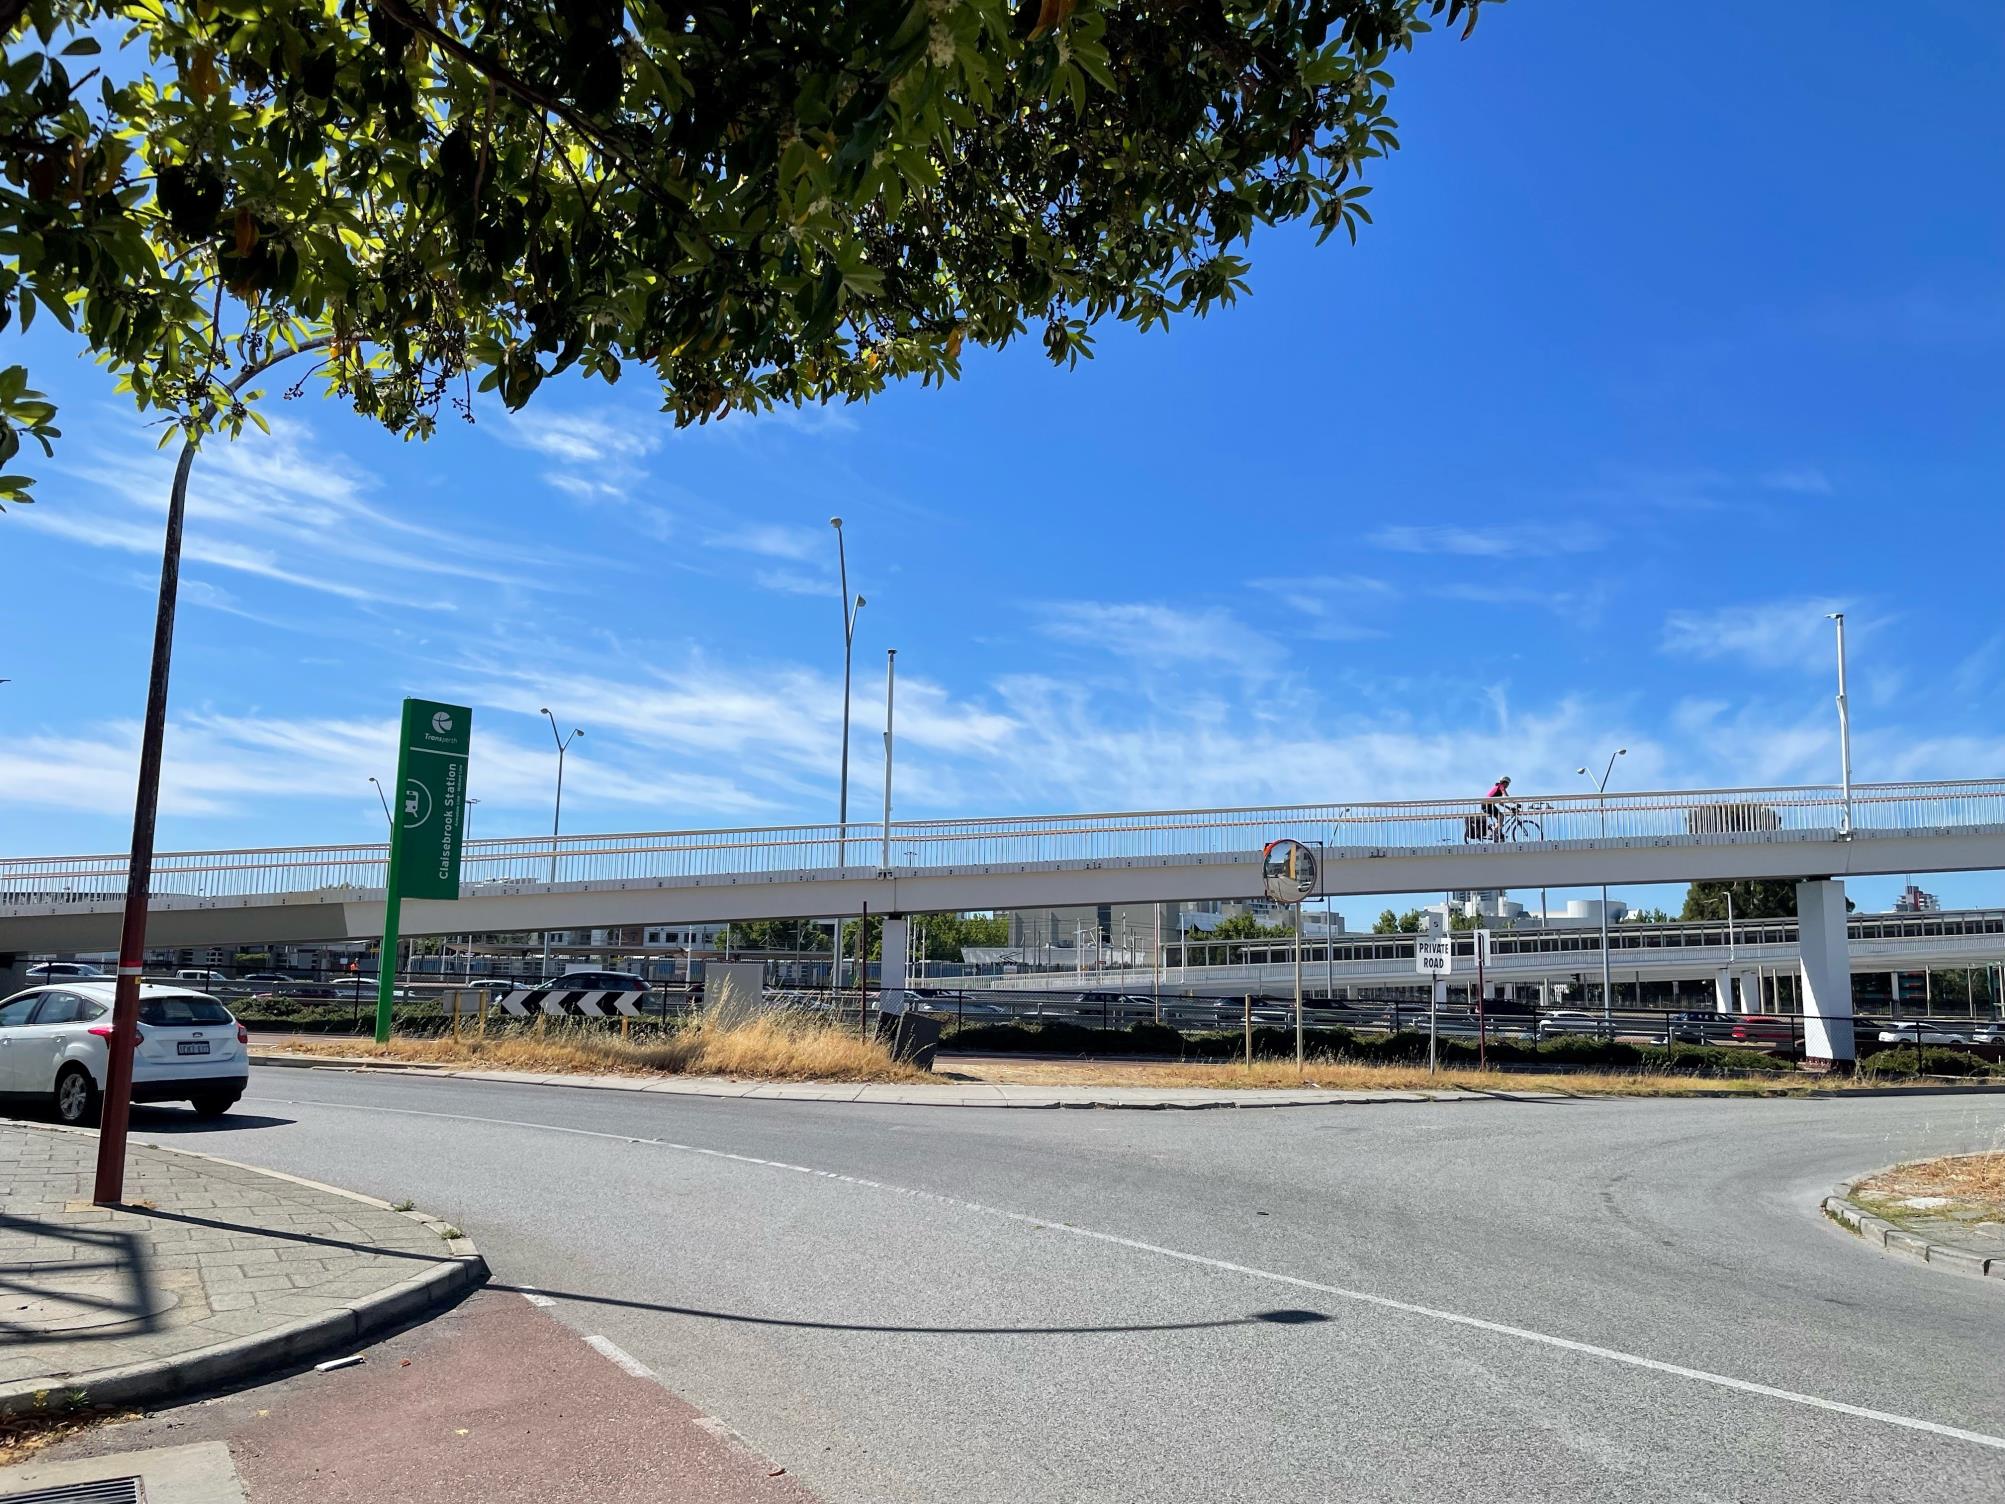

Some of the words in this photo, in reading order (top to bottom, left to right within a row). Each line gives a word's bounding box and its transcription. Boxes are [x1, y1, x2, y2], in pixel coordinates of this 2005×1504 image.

[424, 733, 458, 744] Transperth
[444, 763, 457, 807] Station
[439, 811, 453, 880] Claisebrook
[1419, 943, 1449, 954] PRIVATE
[1424, 957, 1444, 968] ROAD
